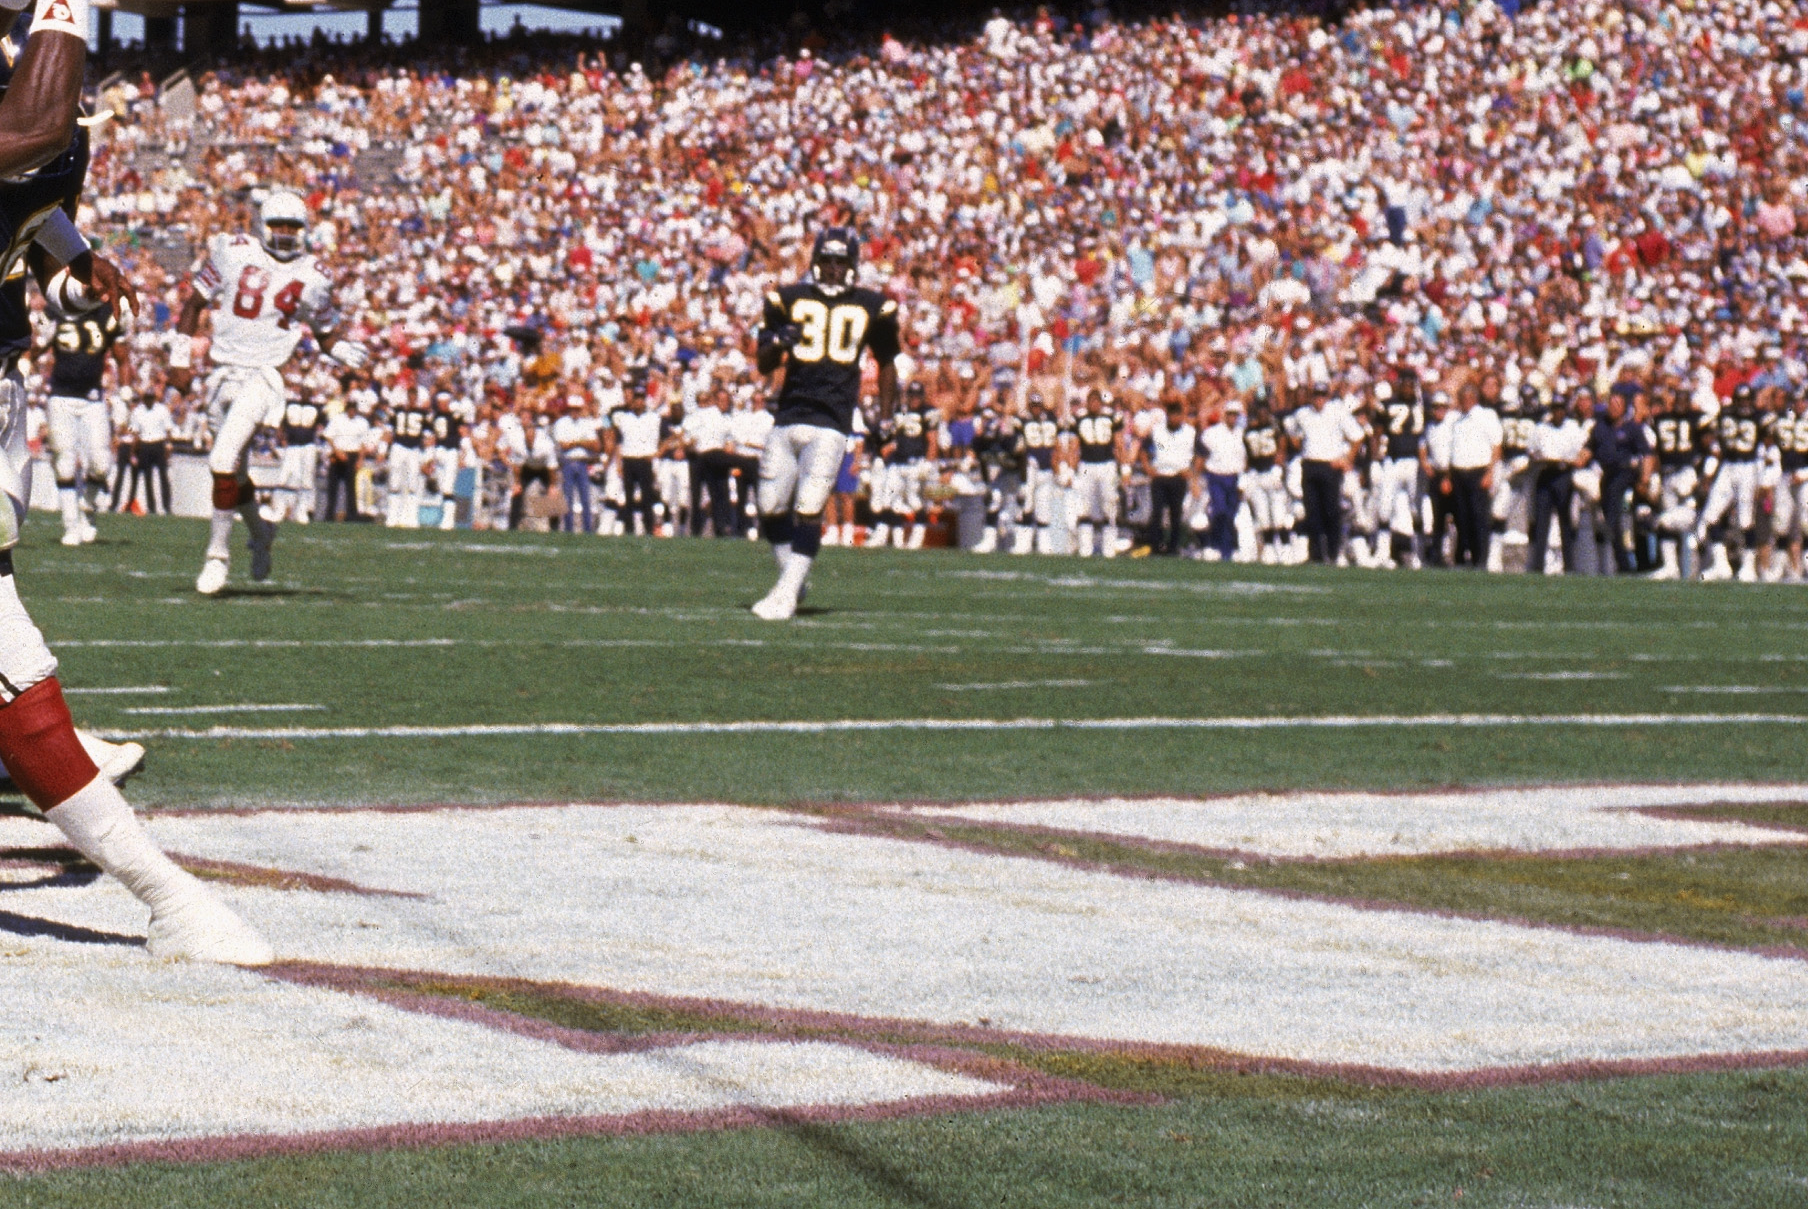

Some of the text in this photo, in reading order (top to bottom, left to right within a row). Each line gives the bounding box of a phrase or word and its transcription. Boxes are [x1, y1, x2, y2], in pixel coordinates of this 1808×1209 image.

[233, 265, 305, 330] 84
[790, 297, 870, 363] 30
[396, 411, 424, 437] 15
[1388, 403, 1425, 435] 71
[1658, 419, 1692, 452] 51
